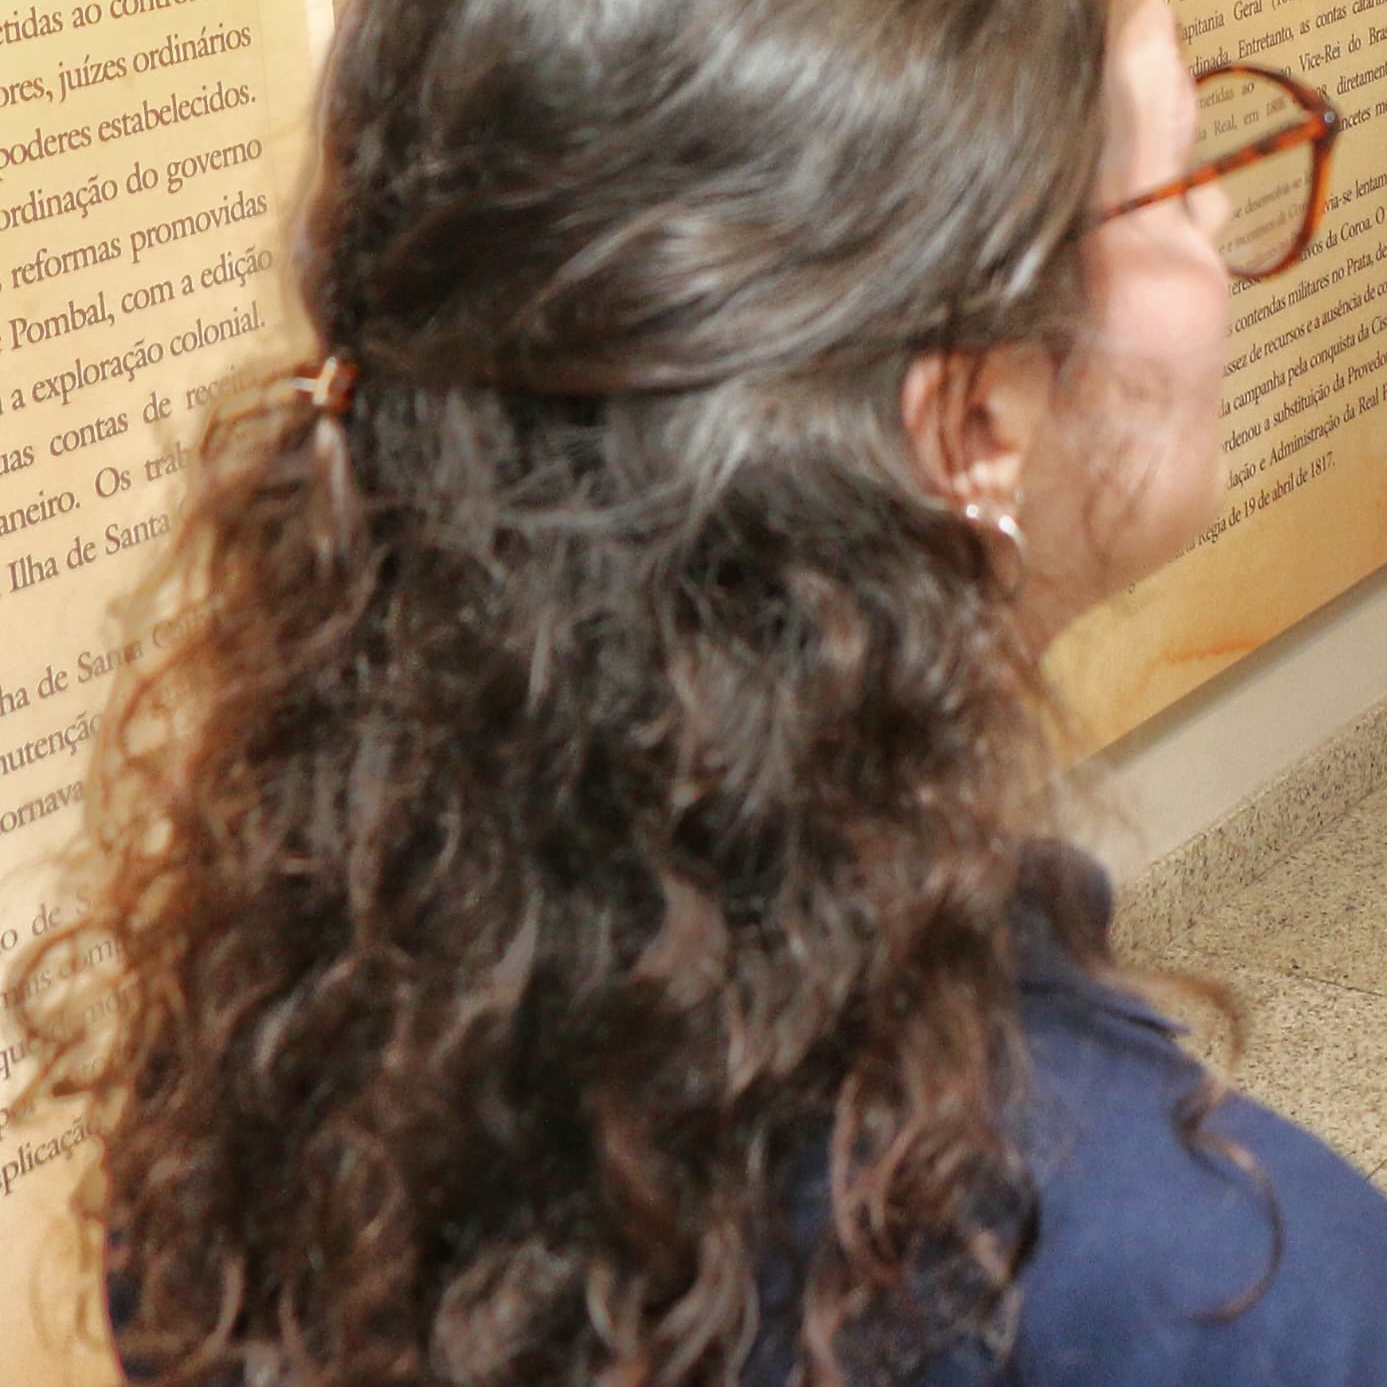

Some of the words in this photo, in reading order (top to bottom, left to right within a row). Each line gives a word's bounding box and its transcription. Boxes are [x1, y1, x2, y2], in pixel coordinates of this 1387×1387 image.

[72, 4, 102, 28] ao
[58, 55, 127, 102] juízes
[133, 23, 251, 72] ordinários
[98, 82, 255, 141] estabelecidos.
[126, 161, 158, 194] do
[167, 139, 262, 193] governo
[11, 238, 121, 288] reformas
[130, 191, 267, 263] promovidas
[8, 292, 114, 349] Pombal,
[121, 281, 174, 313] com
[181, 275, 194, 295] a
[200, 246, 274, 288] edição
[10, 389, 26, 410] a
[32, 340, 163, 405] exploração
[170, 301, 265, 356] colonial.
[50, 413, 128, 456] contas
[143, 391, 171, 430] de
[95, 467, 131, 498] Os
[1228, 506, 1241, 527] de
[1244, 497, 1255, 517] 19
[1257, 489, 1270, 509] de
[1271, 472, 1294, 501] abril
[1296, 466, 1308, 487] de
[1311, 451, 1335, 478] 1817.
[7, 555, 59, 592] Ilha
[66, 536, 96, 569] de
[105, 504, 172, 554] Santa
